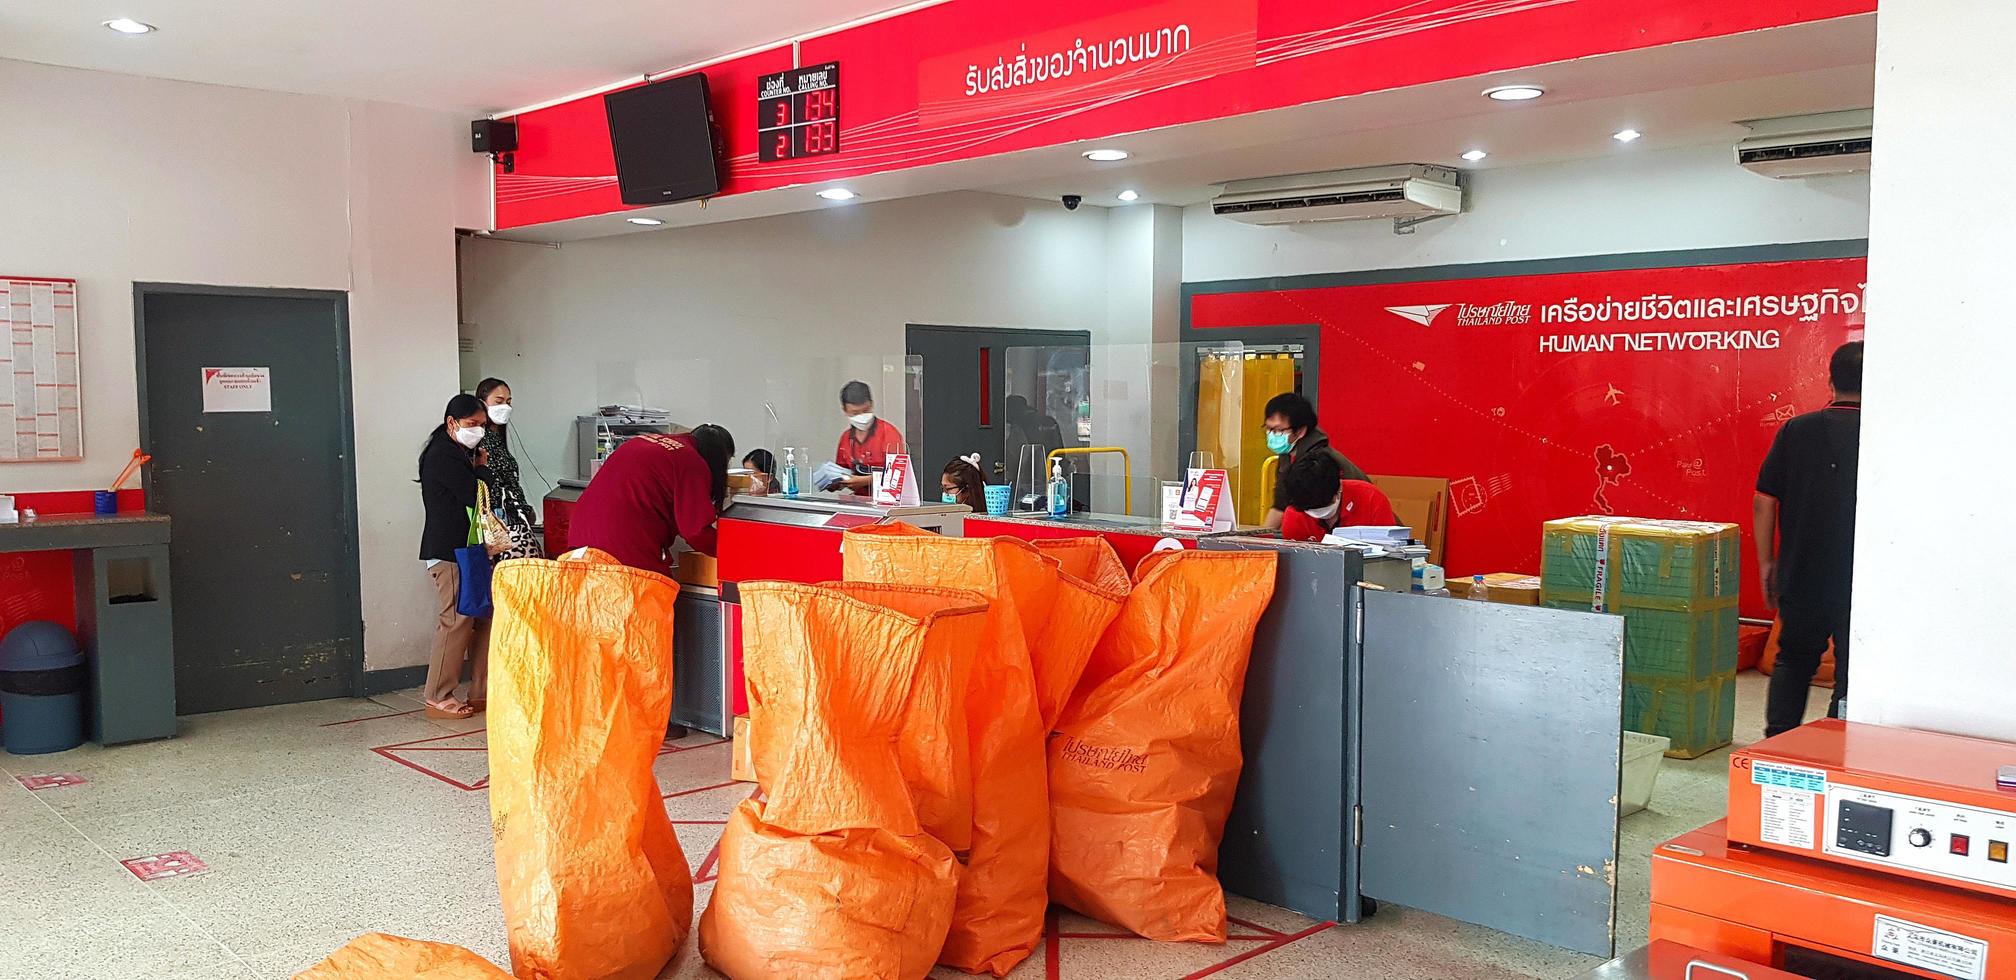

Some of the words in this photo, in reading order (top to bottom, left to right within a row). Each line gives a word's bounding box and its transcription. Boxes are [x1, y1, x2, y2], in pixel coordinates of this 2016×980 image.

[965, 24, 1190, 96] รับส่งสิ่งของจำนวนมาก
[761, 88, 782, 98] COUNTER
[805, 88, 835, 121] 134
[777, 103, 786, 126] 3
[776, 135, 786, 158] 2
[805, 121, 835, 153] 133
[1457, 316, 1502, 327] THAILAND
[1505, 315, 1531, 325] POST
[1540, 334, 1614, 353] HUMAN
[1623, 330, 1780, 351] NETWORKING
[1595, 566, 1604, 600] FRAGILE
[1062, 752, 1114, 769] THAILAND
[1117, 763, 1147, 774] POST
[1733, 757, 1749, 769] CE
